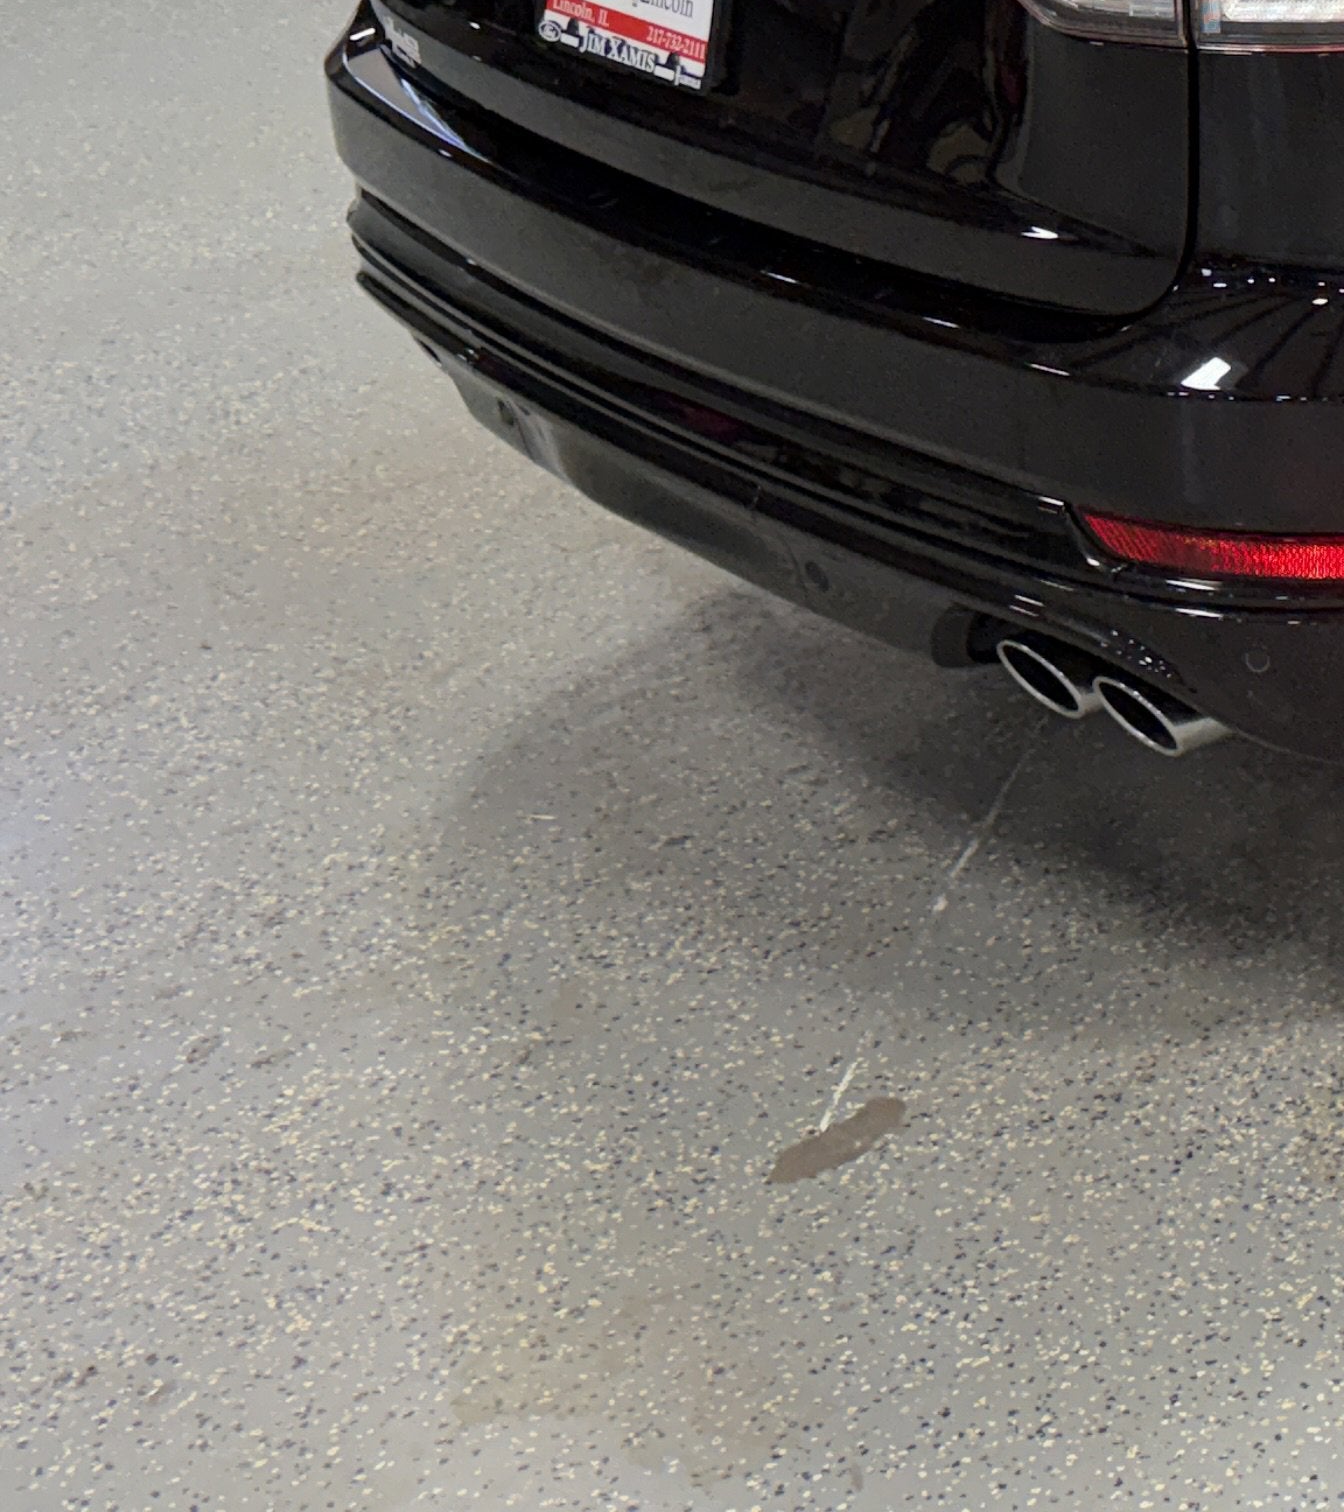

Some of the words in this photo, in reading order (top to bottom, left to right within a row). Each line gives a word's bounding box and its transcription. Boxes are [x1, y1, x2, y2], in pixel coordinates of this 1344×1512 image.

[597, 9, 610, 27] IL
[579, 30, 605, 56] JIM
[607, 38, 656, 74] XAMIS
